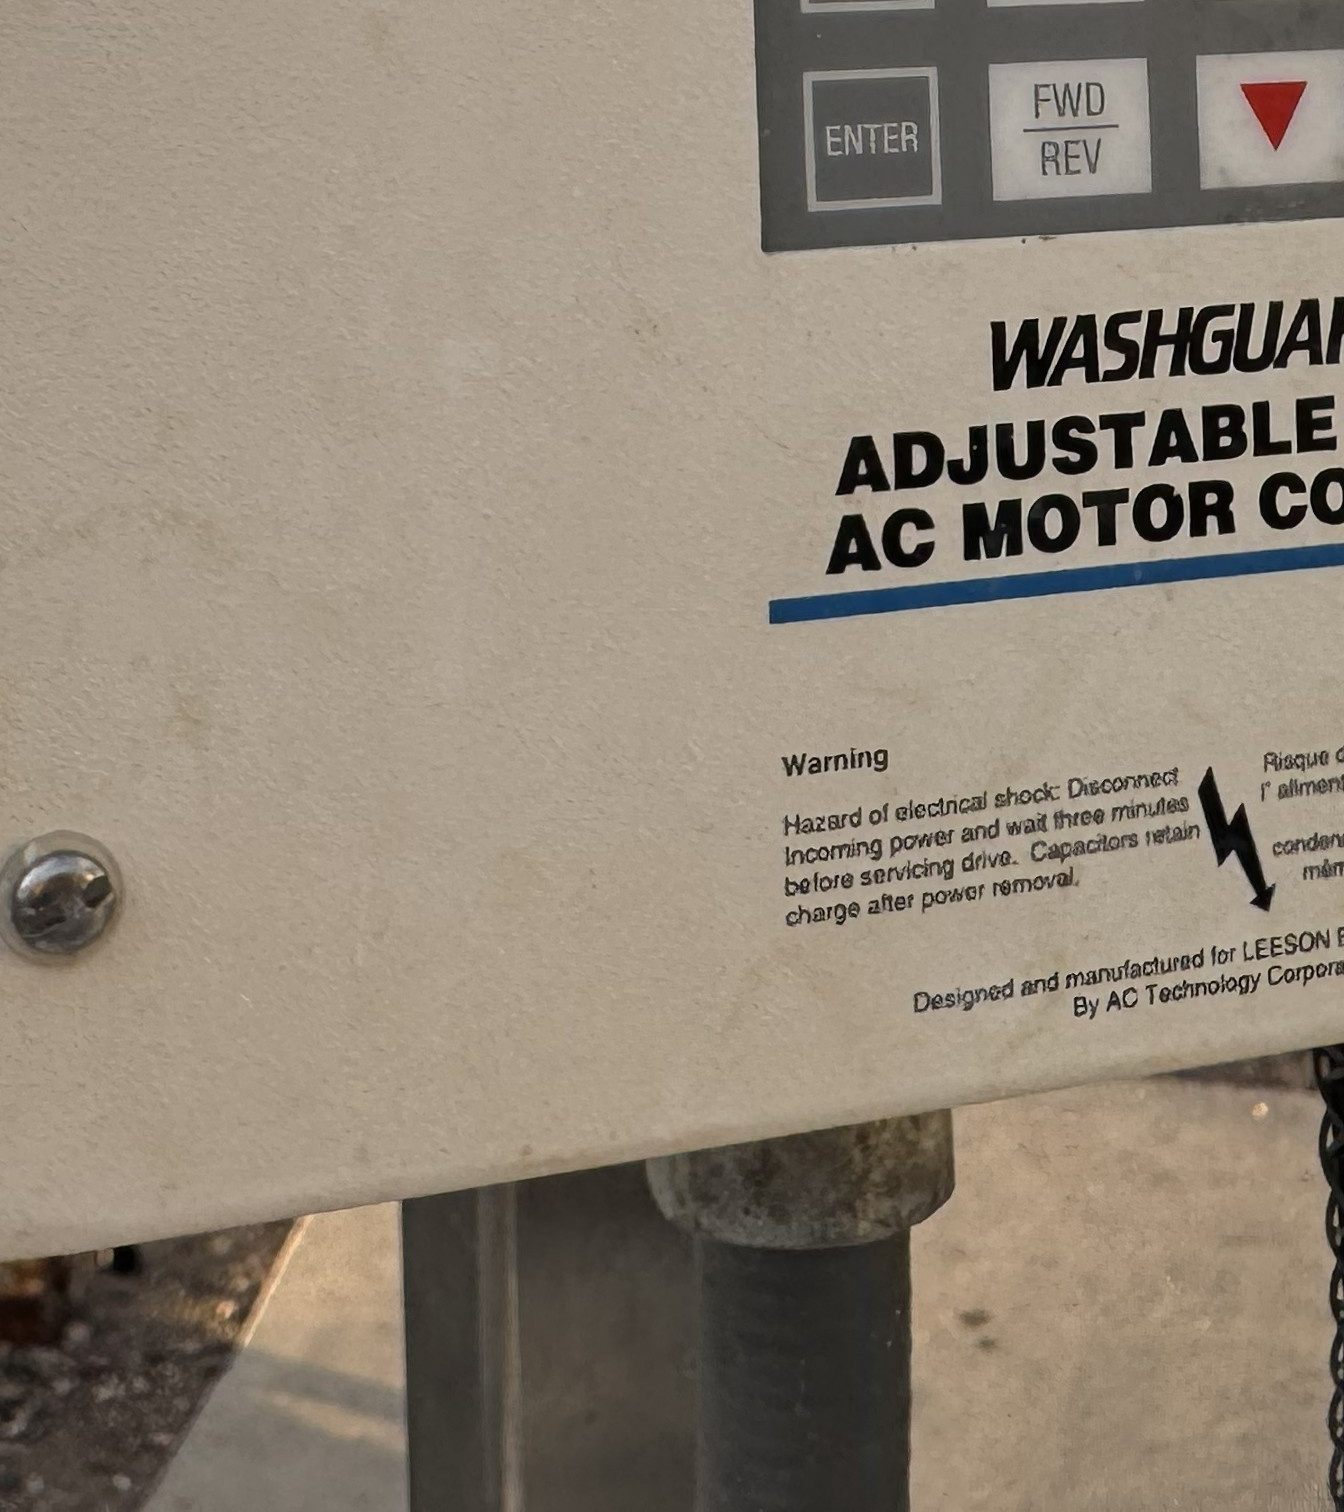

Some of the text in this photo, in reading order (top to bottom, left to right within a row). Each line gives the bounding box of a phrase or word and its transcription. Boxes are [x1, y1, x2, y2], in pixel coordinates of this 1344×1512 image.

[1033, 81, 1106, 120] FWD
[824, 120, 920, 158] ENTER
[1040, 137, 1103, 177] REV
[834, 394, 1338, 495] ADJUSTABLE
[825, 506, 936, 575] AC
[962, 479, 1237, 562] MOTOR
[781, 747, 889, 777] Warning
[1263, 749, 1330, 774] Risque
[783, 806, 863, 837] Hazard
[868, 801, 890, 826] of
[894, 791, 988, 823] electrical
[1067, 766, 1180, 800] Disconnect
[889, 829, 955, 859] power
[960, 818, 1000, 844] and
[1005, 812, 1049, 837] wait
[1052, 806, 1106, 830] three
[1111, 795, 1191, 823] minutes
[784, 820, 1201, 898] before servicing drive. Capacitors retain
[785, 866, 1081, 928] charge after power removal.
[912, 978, 1015, 1013] Designed
[1020, 971, 1060, 998] and
[1065, 949, 1205, 990] manufactured
[1210, 944, 1237, 967] for
[1242, 928, 1332, 962] LEESON
[1073, 995, 1100, 1021] By
[1106, 986, 1140, 1013] AC
[1146, 972, 1262, 1006] Technology
